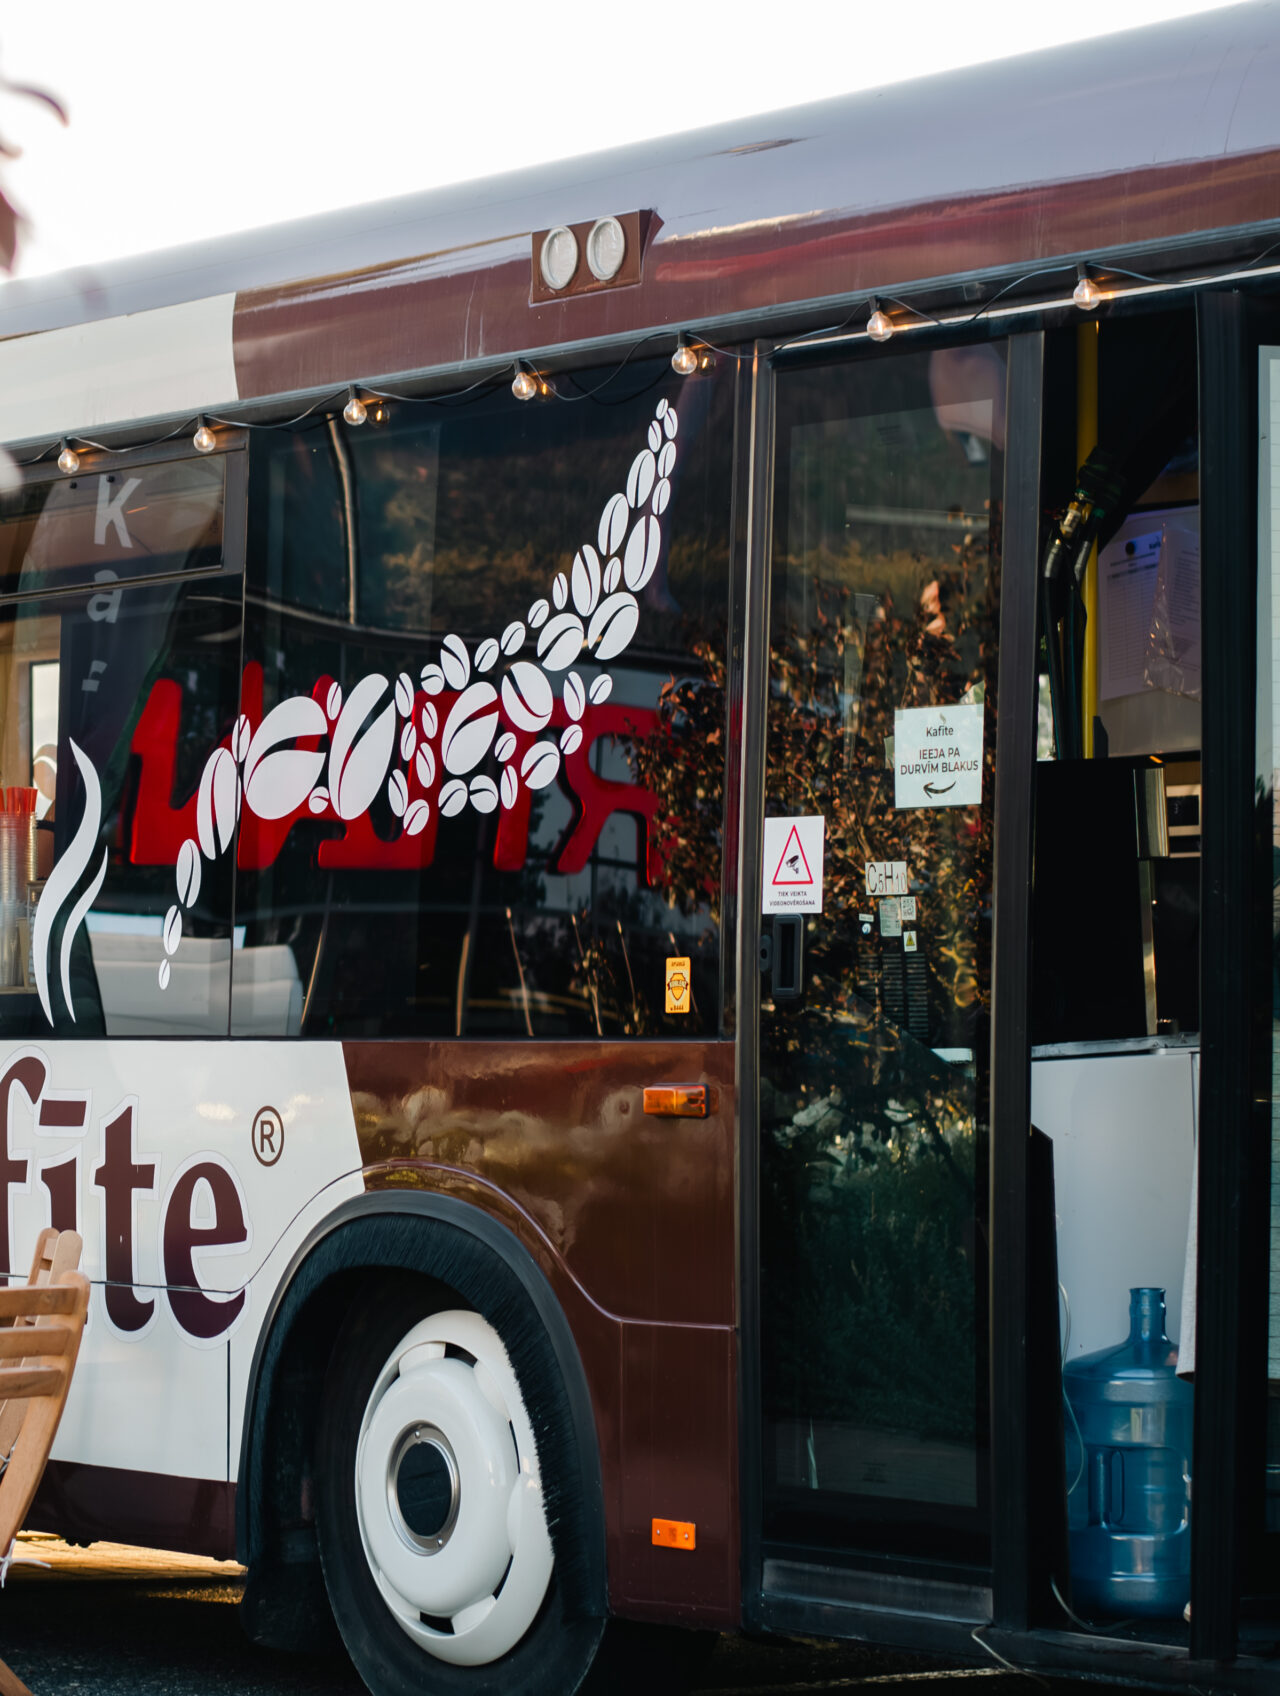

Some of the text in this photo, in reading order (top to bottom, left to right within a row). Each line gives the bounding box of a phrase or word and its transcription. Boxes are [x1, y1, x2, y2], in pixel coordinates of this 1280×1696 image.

[919, 747, 960, 760] IEEJA PA
[900, 760, 979, 775] DURVĪM BLAKUS
